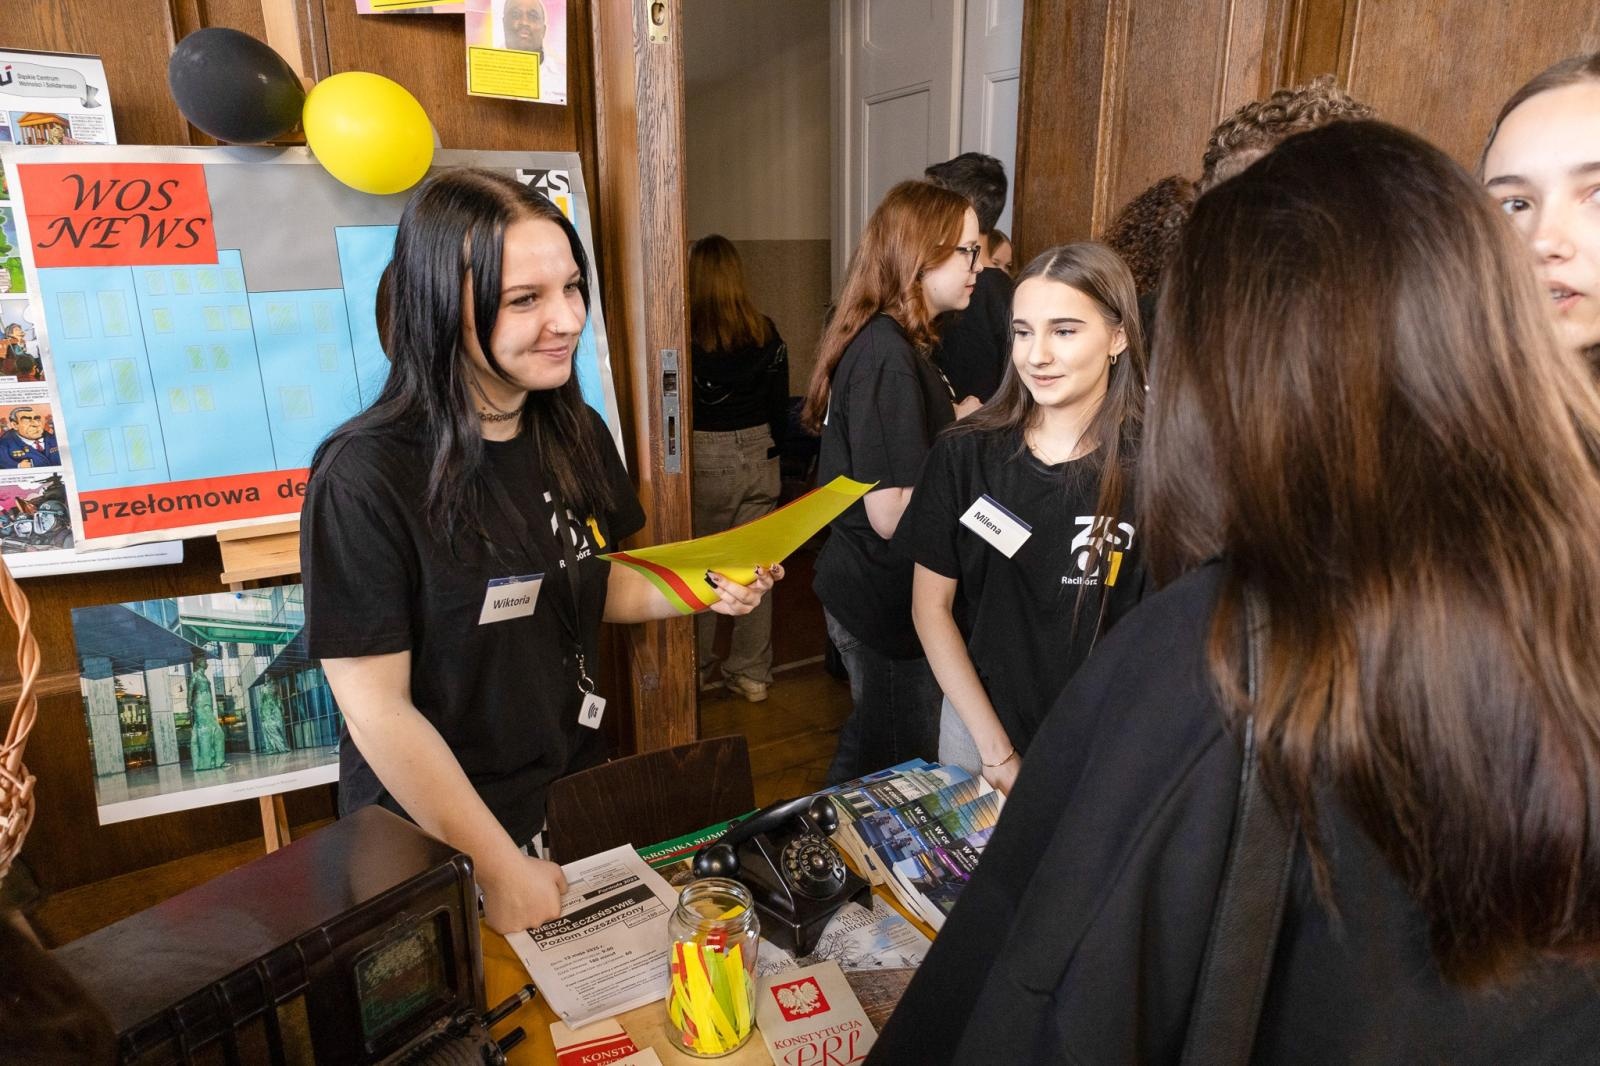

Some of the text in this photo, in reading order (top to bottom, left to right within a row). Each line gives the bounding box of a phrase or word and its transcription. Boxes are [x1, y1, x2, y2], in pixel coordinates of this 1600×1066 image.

[62, 174, 179, 211] WOS
[37, 213, 206, 249] NEWS
[82, 486, 261, 522] Przełomowa
[973, 511, 1003, 536] Milena
[493, 595, 531, 610] Wiktoria
[642, 842, 694, 861] KRONIKA
[529, 918, 572, 935] WIEDZA
[540, 931, 581, 948] Poziom
[583, 905, 645, 935] rozszerzony
[545, 898, 636, 937] SPOŁECZEŃSTWIE
[774, 1020, 863, 1050] KONSTYTUCJA
[581, 1044, 635, 1064] KONSTY
